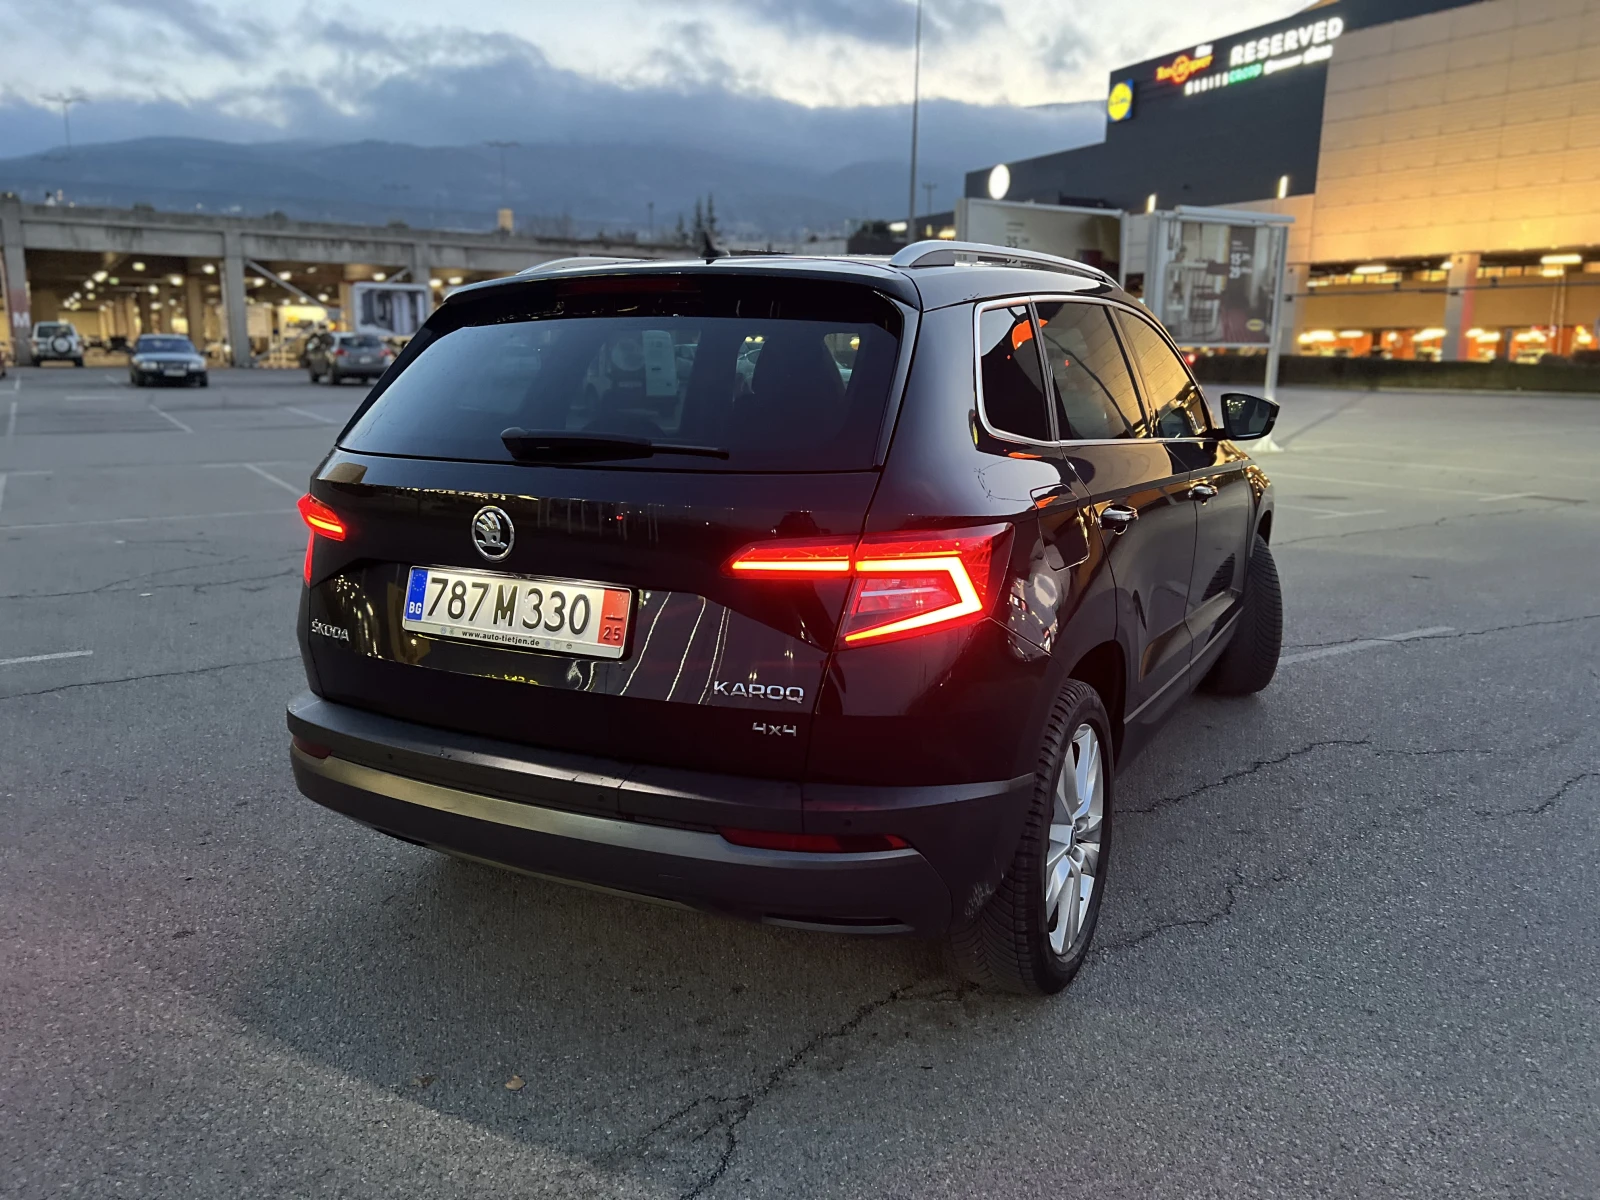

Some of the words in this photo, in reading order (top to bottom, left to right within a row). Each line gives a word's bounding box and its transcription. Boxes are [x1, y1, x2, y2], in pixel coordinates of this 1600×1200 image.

[1229, 16, 1344, 67] RESERVED
[408, 601, 422, 615] BG
[427, 577, 491, 622] 787
[492, 584, 519, 627] M
[522, 587, 590, 636] 330
[461, 630, 540, 647] www.auto-tietjen.de
[603, 625, 622, 641] 25
[713, 681, 804, 704] KAROQ
